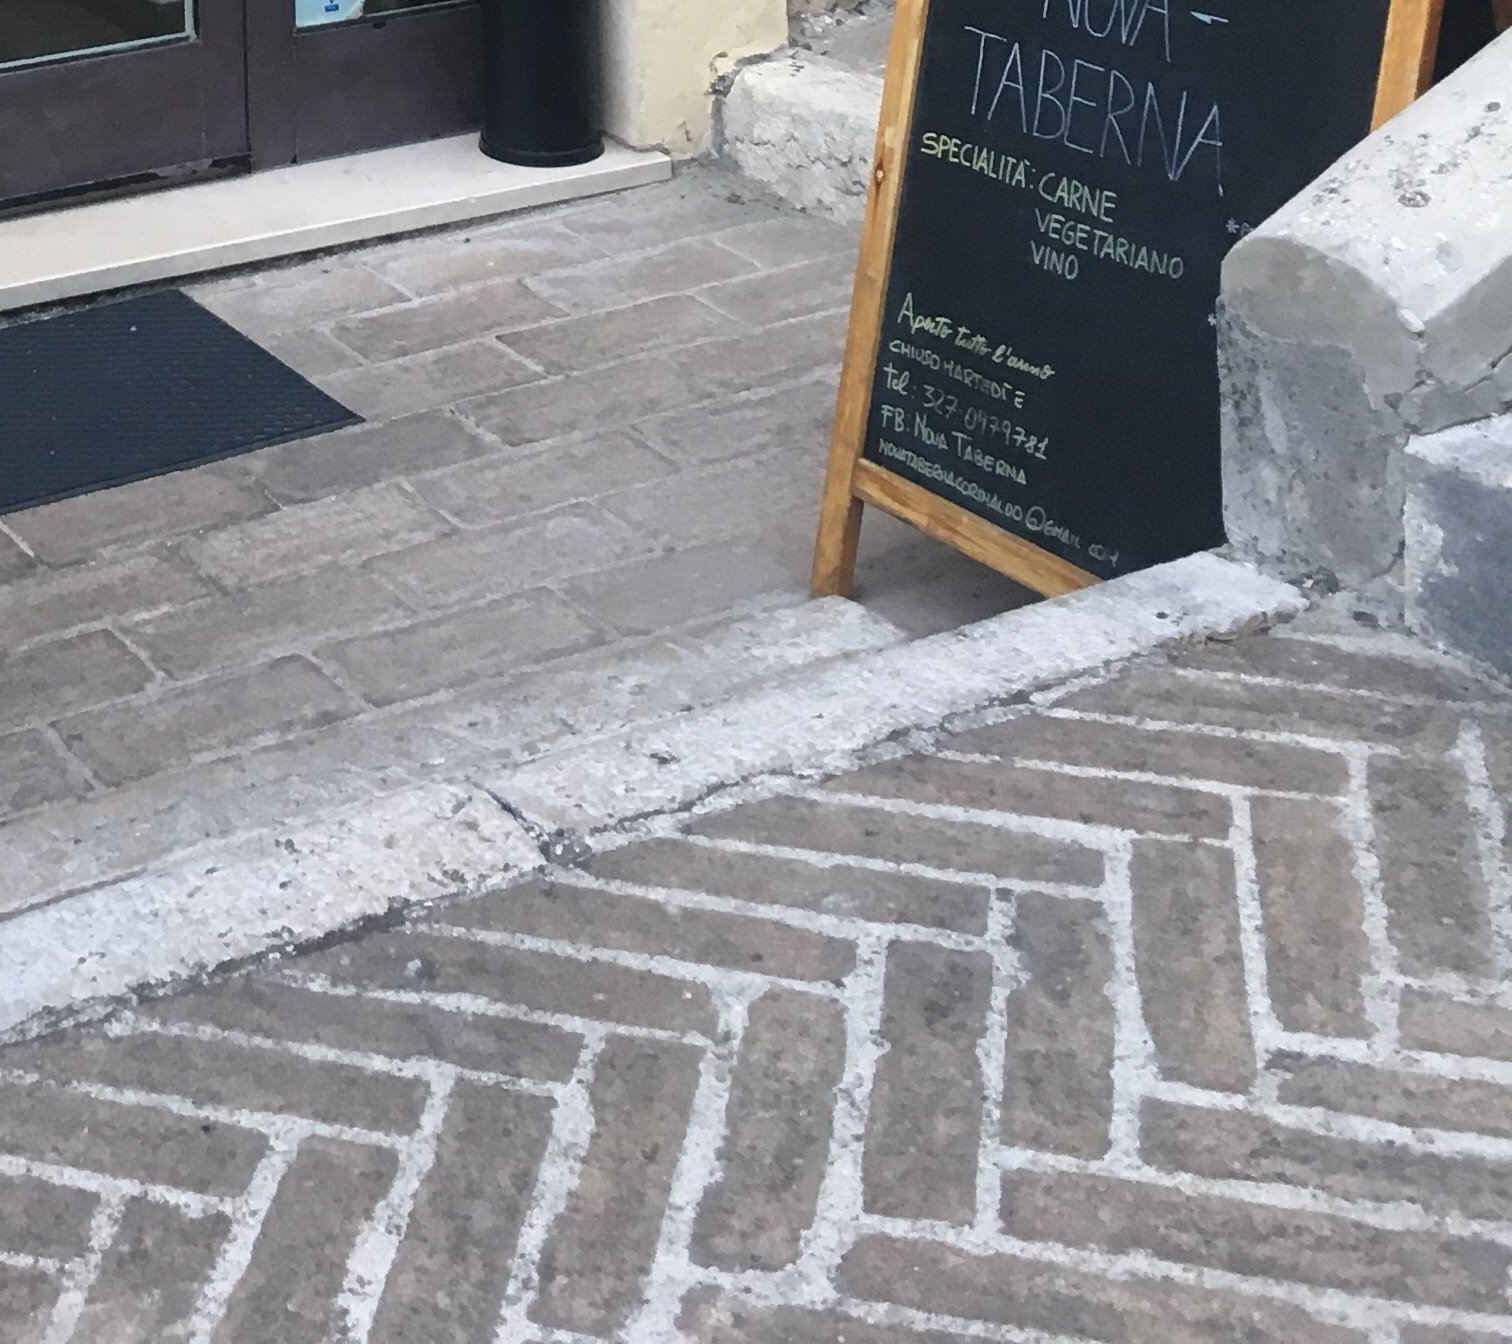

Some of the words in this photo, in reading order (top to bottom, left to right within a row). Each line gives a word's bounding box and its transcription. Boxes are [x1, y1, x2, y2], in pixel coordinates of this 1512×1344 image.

[964, 25, 1224, 197] TABERNA
[1038, 172, 1118, 223] CARNE
[1030, 240, 1079, 280] VINO
[1035, 208, 1185, 279] VEGETARIANO
[897, 292, 953, 337] Aperto
[889, 339, 941, 370] CHIUSO
[952, 430, 1027, 485] TABERNA
